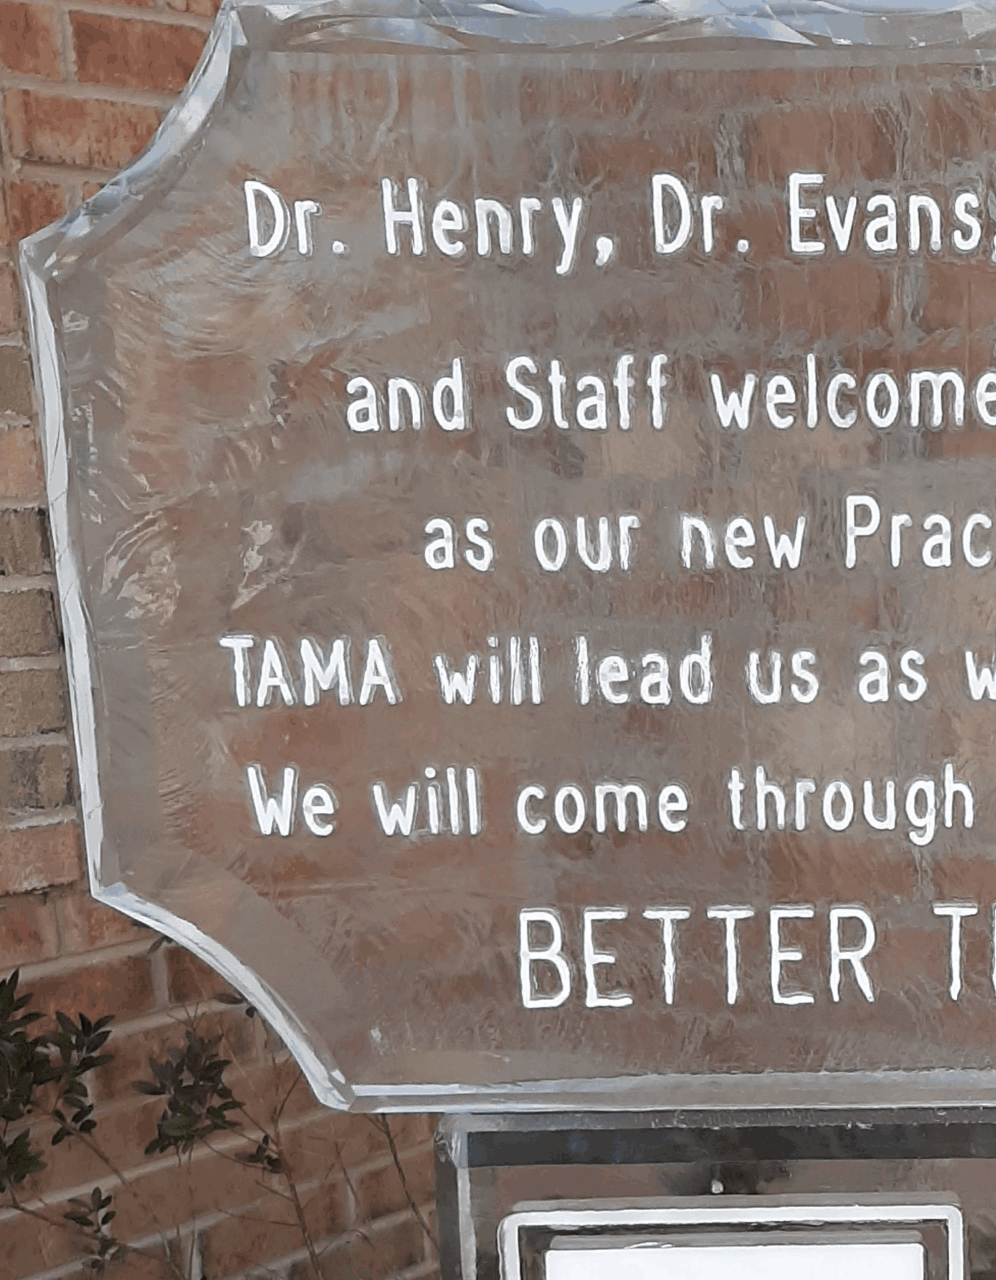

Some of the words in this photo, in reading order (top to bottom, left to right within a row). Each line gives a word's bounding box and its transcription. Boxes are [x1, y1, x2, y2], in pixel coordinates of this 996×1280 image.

[242, 178, 347, 257] Dr.
[381, 177, 614, 275] Henry,
[650, 172, 750, 255] Dr.
[346, 357, 466, 433] and
[505, 354, 668, 430] Staff
[424, 516, 494, 571] as
[534, 515, 641, 571] our
[681, 512, 806, 568] new
[219, 634, 400, 706] TAMA
[433, 635, 541, 705] will
[575, 633, 713, 705] lead
[746, 649, 819, 704] us
[858, 647, 927, 702] as
[247, 764, 336, 837] We
[372, 766, 480, 836] will
[516, 783, 689, 833] come
[728, 762, 974, 846] through
[519, 905, 875, 1009] BETTER
